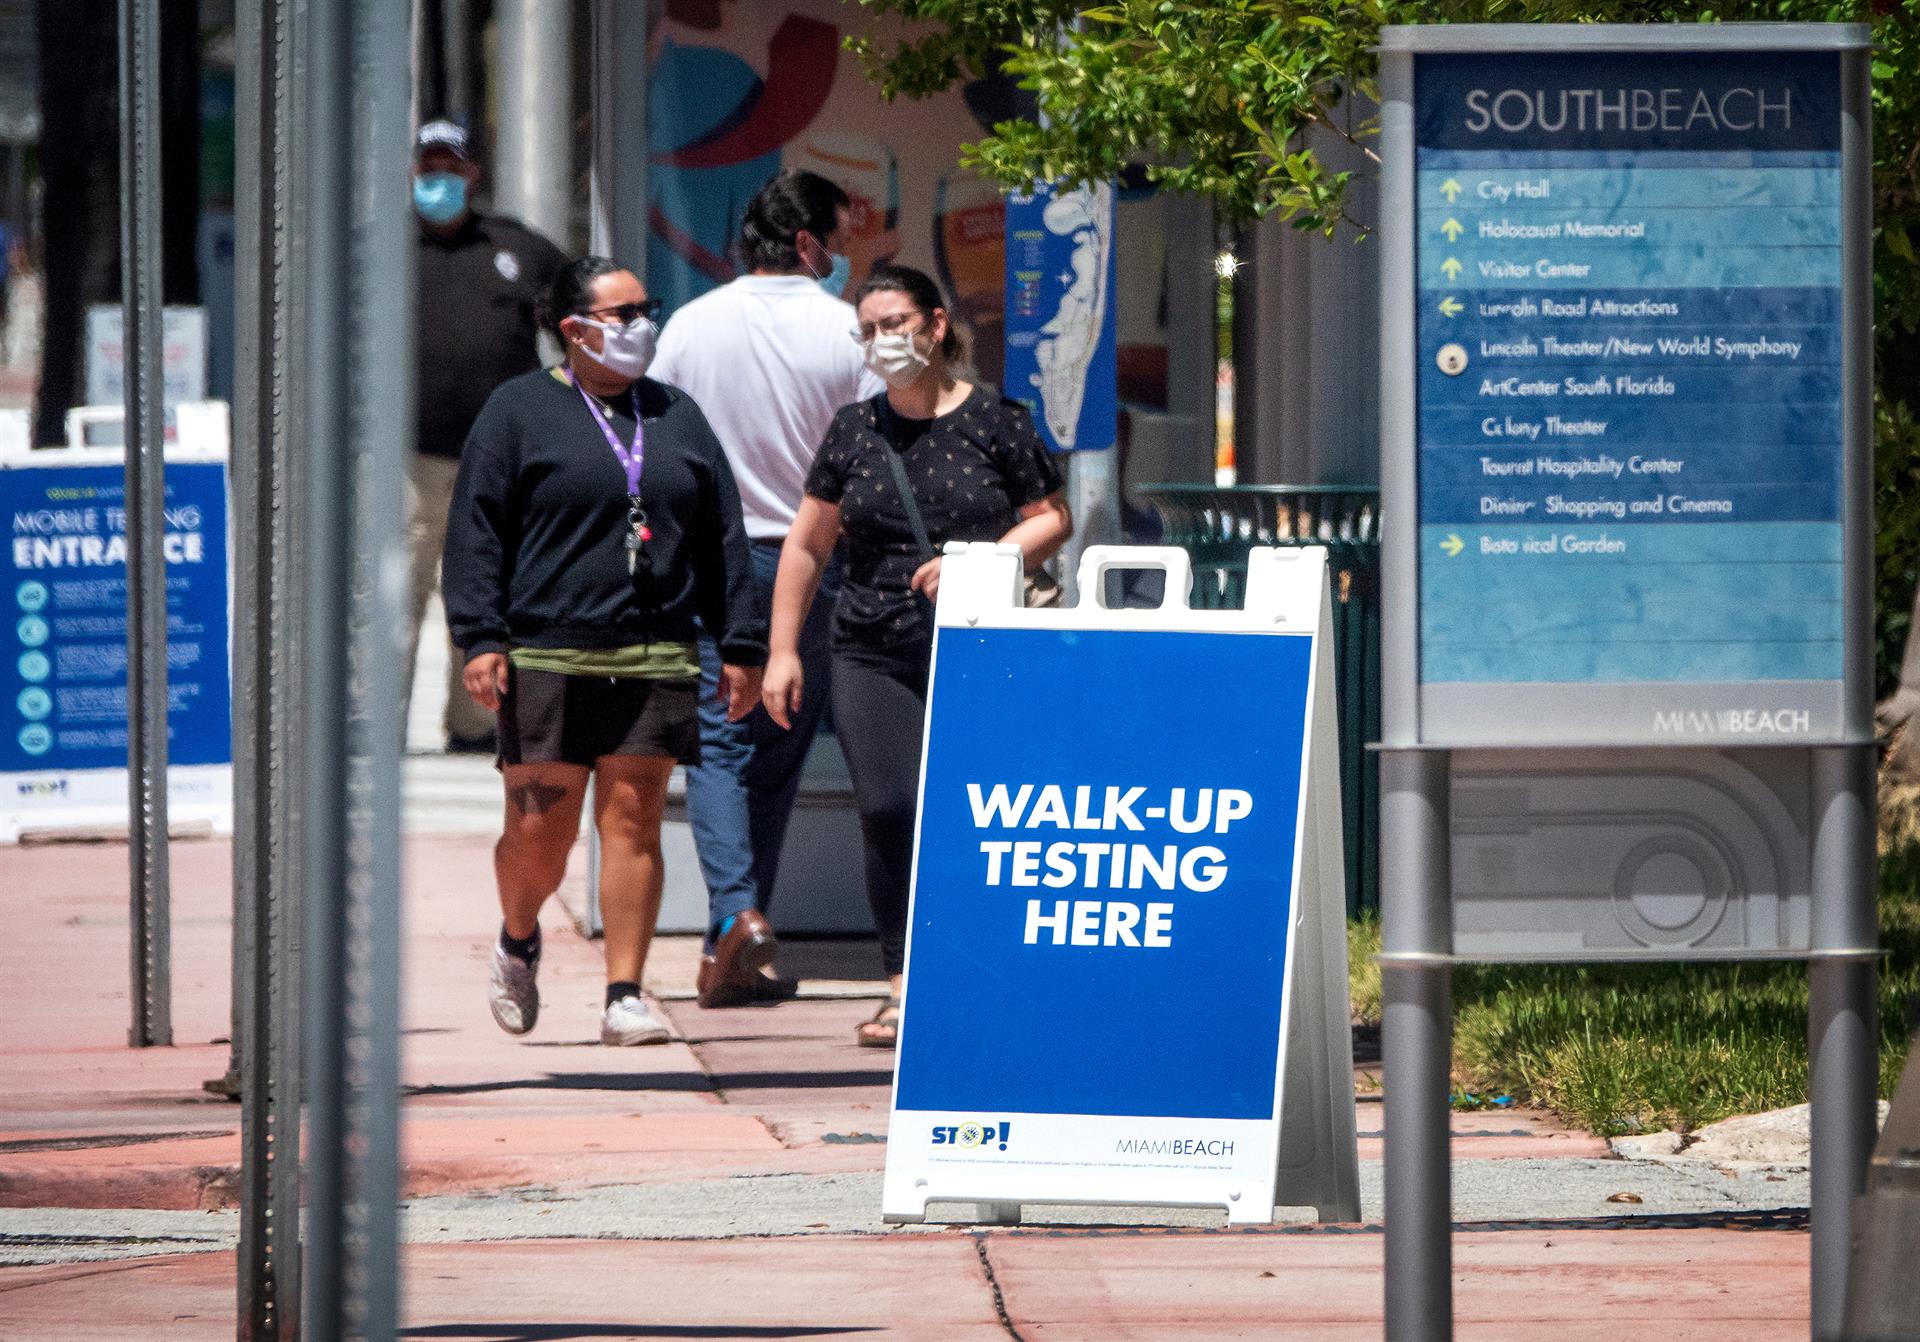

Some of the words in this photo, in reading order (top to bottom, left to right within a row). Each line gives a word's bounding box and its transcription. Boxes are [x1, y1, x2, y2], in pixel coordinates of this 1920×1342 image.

[1465, 88, 1791, 131] SOUTHBEACH
[1477, 180, 1511, 203] City
[1515, 178, 1550, 198] Hall
[1478, 219, 1561, 238] Holocaust
[1564, 219, 1645, 238] Memorial
[1478, 259, 1532, 278] Visitor
[1535, 258, 1591, 278] Center
[1541, 296, 1586, 316] Road
[1589, 298, 1679, 316] Attractions
[1656, 336, 1710, 355] World
[1714, 336, 1801, 360] Symphony
[1479, 377, 1560, 396] ArtCenter
[1564, 375, 1611, 395] South
[1616, 375, 1675, 395] Florida
[1544, 415, 1607, 436] Theater
[1480, 456, 1533, 475] Tourist
[1536, 455, 1624, 479] Hospitality
[1627, 455, 1684, 473] Center
[1545, 494, 1626, 518] Shopping
[1629, 494, 1663, 513] and
[1667, 494, 1733, 513] Cinema
[13, 507, 99, 535] MOBILE
[105, 504, 202, 532] TENG
[13, 531, 204, 570] ENTRACE
[1561, 533, 1626, 554] Garden
[966, 783, 1254, 834] WALK-UP
[979, 841, 1228, 893] TESTING
[1023, 899, 1174, 948] HERE
[931, 1121, 1011, 1152] STOP!
[1115, 1138, 1234, 1156] MIAMIBEACH
